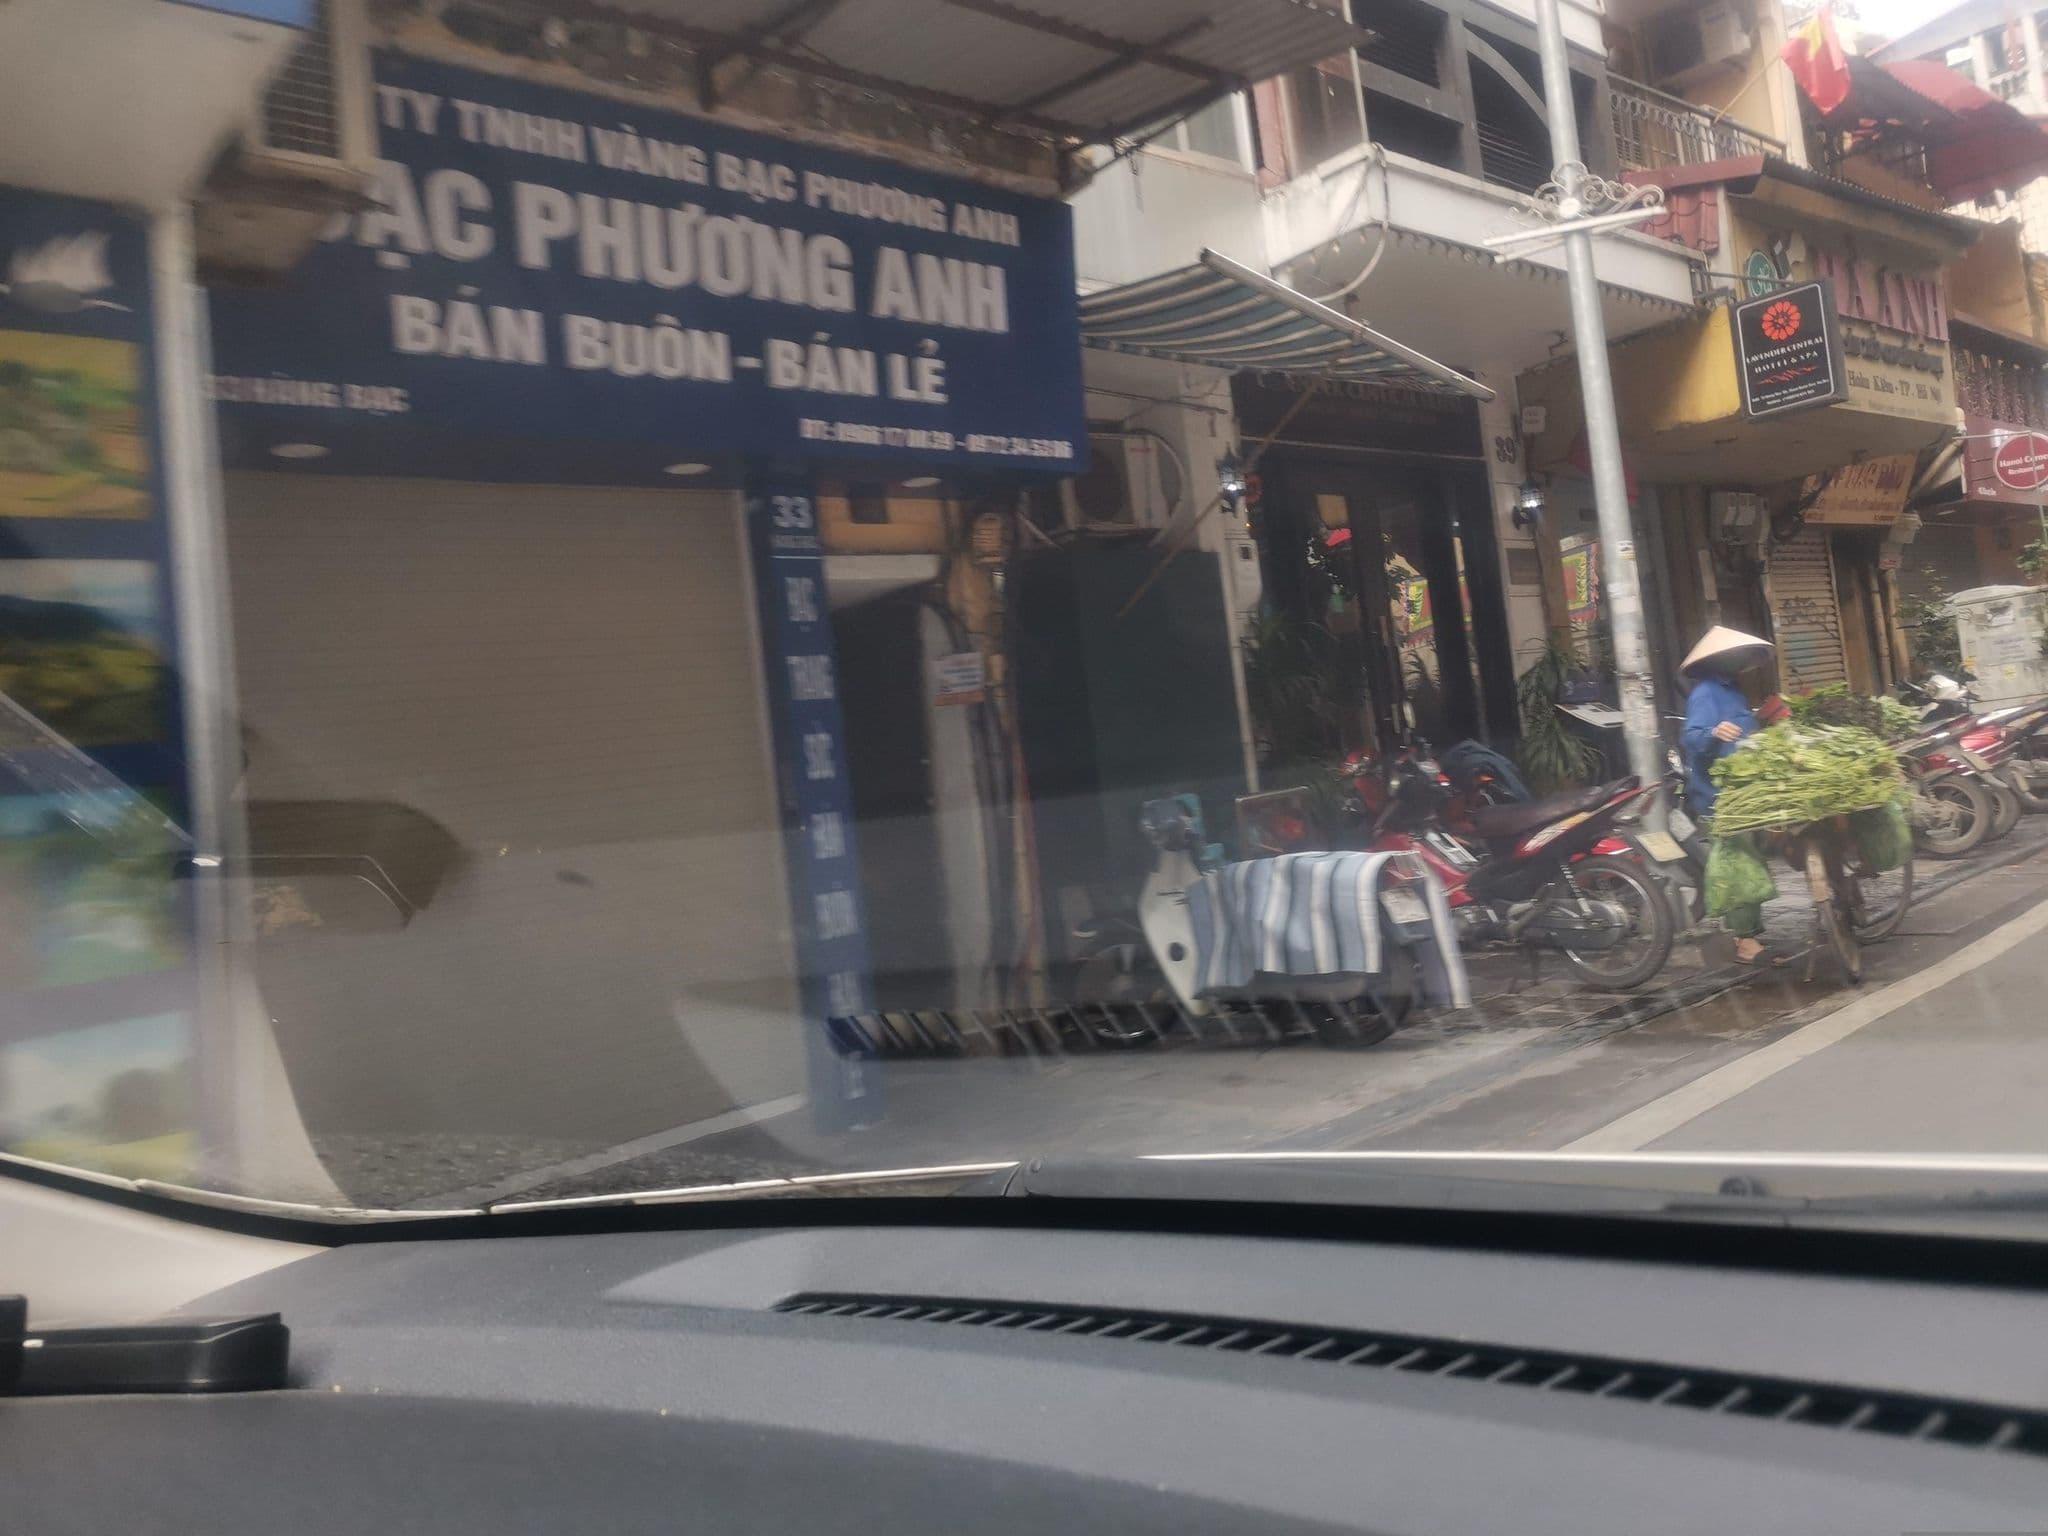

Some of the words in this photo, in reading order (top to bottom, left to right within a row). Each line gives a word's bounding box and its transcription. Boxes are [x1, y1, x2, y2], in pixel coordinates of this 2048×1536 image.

[378, 84, 443, 135] TY
[452, 98, 585, 162] TNHH
[589, 122, 708, 186] VÀNG
[715, 152, 797, 204] BẠC
[804, 171, 948, 232] PHƯƠNG
[952, 203, 1020, 247] ANH
[313, 159, 495, 270] ẠC
[513, 180, 856, 313] PHƯƠNG
[870, 246, 1009, 334] ANH
[391, 285, 547, 365] BÁN
[563, 312, 732, 382] BUÔN
[766, 331, 879, 397] BÁN
[886, 338, 949, 404] LẺ
[772, 495, 814, 529] 33
